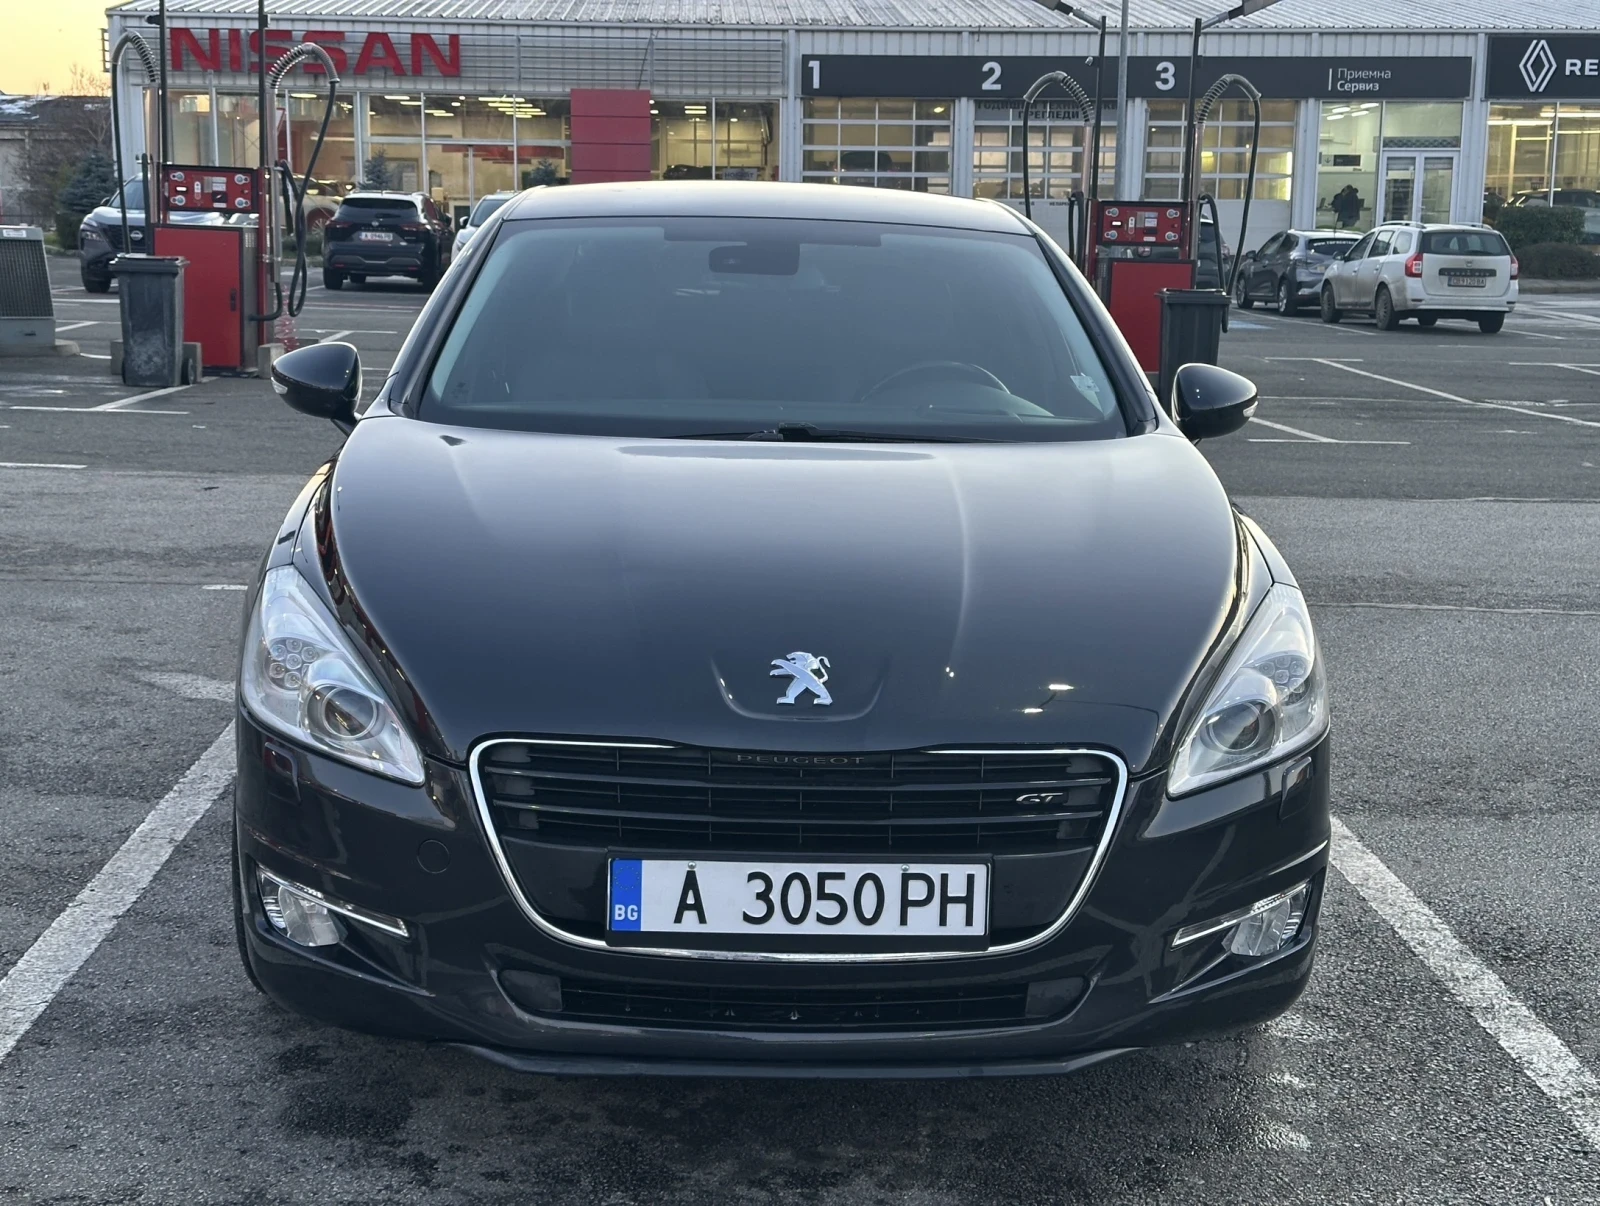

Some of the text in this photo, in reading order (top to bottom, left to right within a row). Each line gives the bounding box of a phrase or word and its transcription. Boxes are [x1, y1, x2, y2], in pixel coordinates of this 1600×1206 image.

[169, 27, 460, 76] NISSAN
[808, 60, 820, 89] 1
[981, 61, 1002, 91] 2
[1155, 61, 1176, 91] 3
[1338, 68, 1391, 81] Приемна
[1337, 80, 1379, 93] Сервиз
[737, 754, 865, 764] PEUGEOT
[1015, 791, 1064, 805] GT
[673, 870, 974, 927] A 3050 PH
[615, 905, 638, 921] BG
